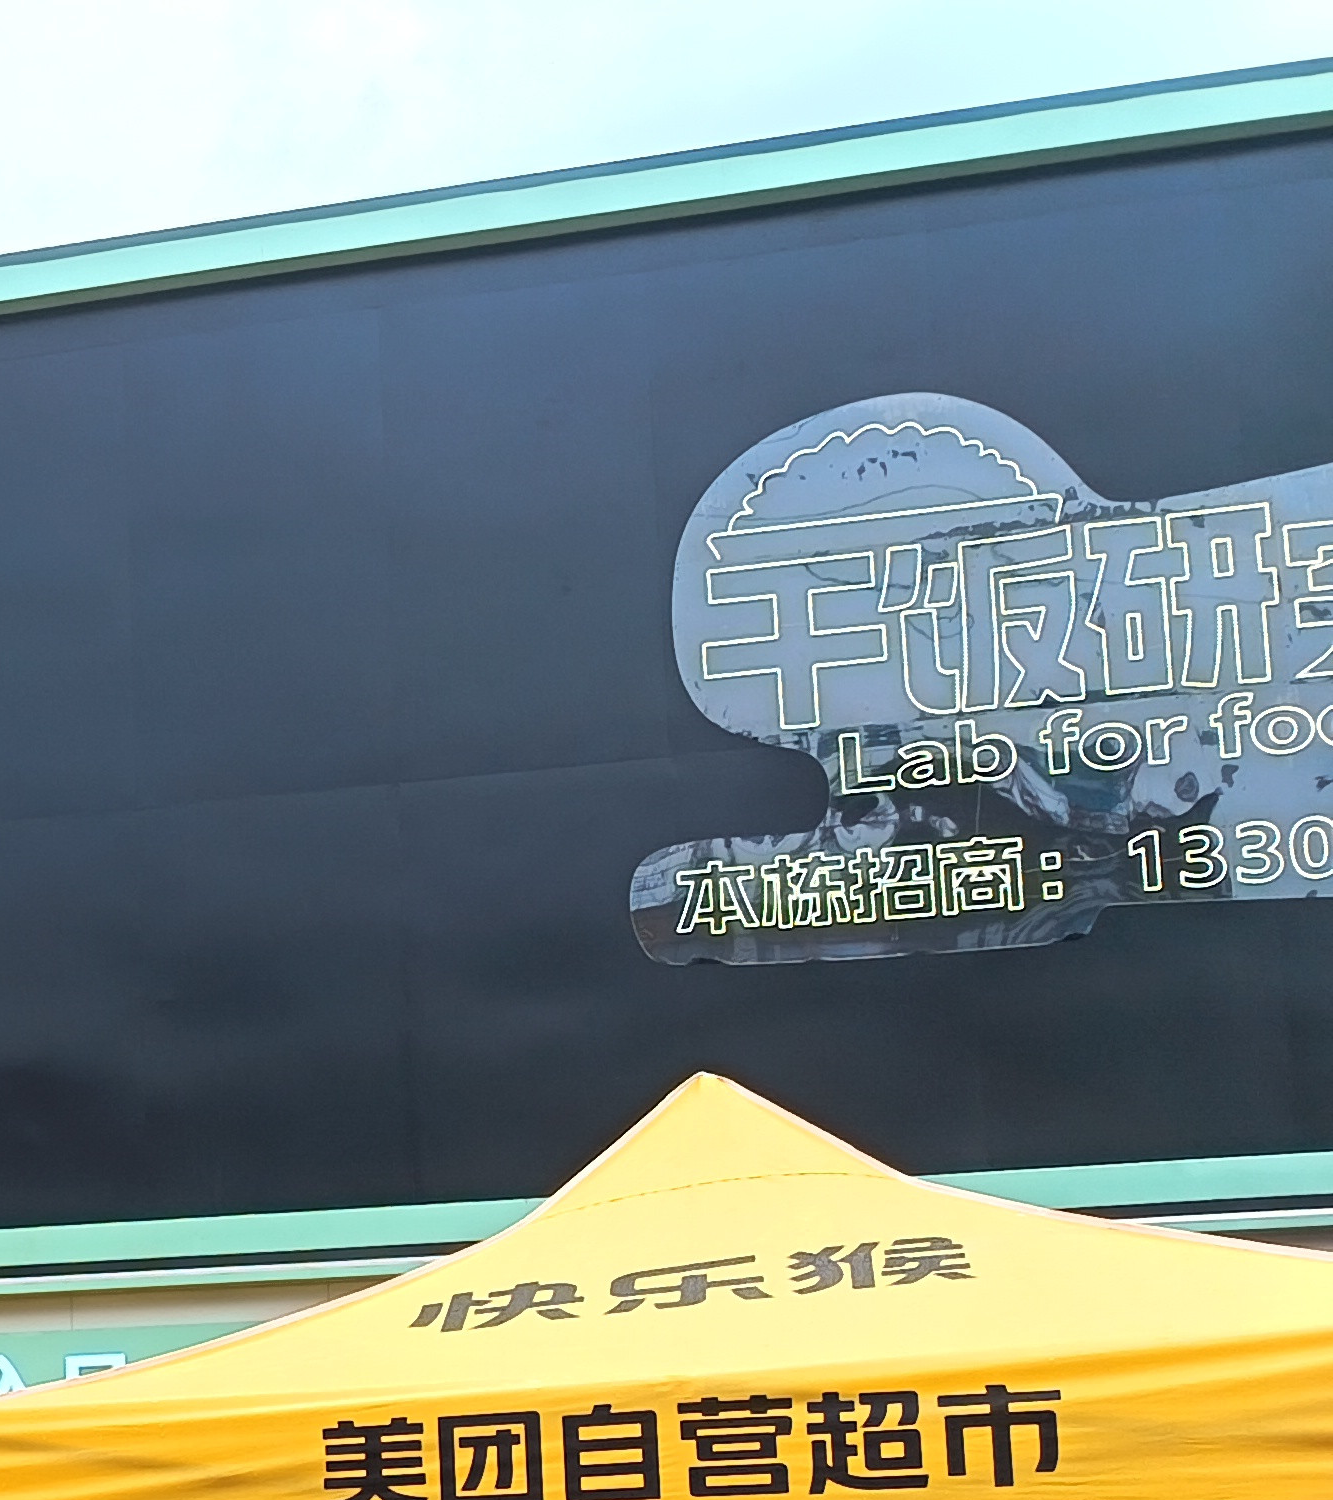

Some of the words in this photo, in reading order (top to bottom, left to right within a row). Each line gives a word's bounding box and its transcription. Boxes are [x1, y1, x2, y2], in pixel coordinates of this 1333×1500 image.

[838, 720, 1018, 796] Lab
[1039, 708, 1187, 775] for
[1212, 692, 1333, 758] fo
[409, 1235, 976, 1336] 快乐猴
